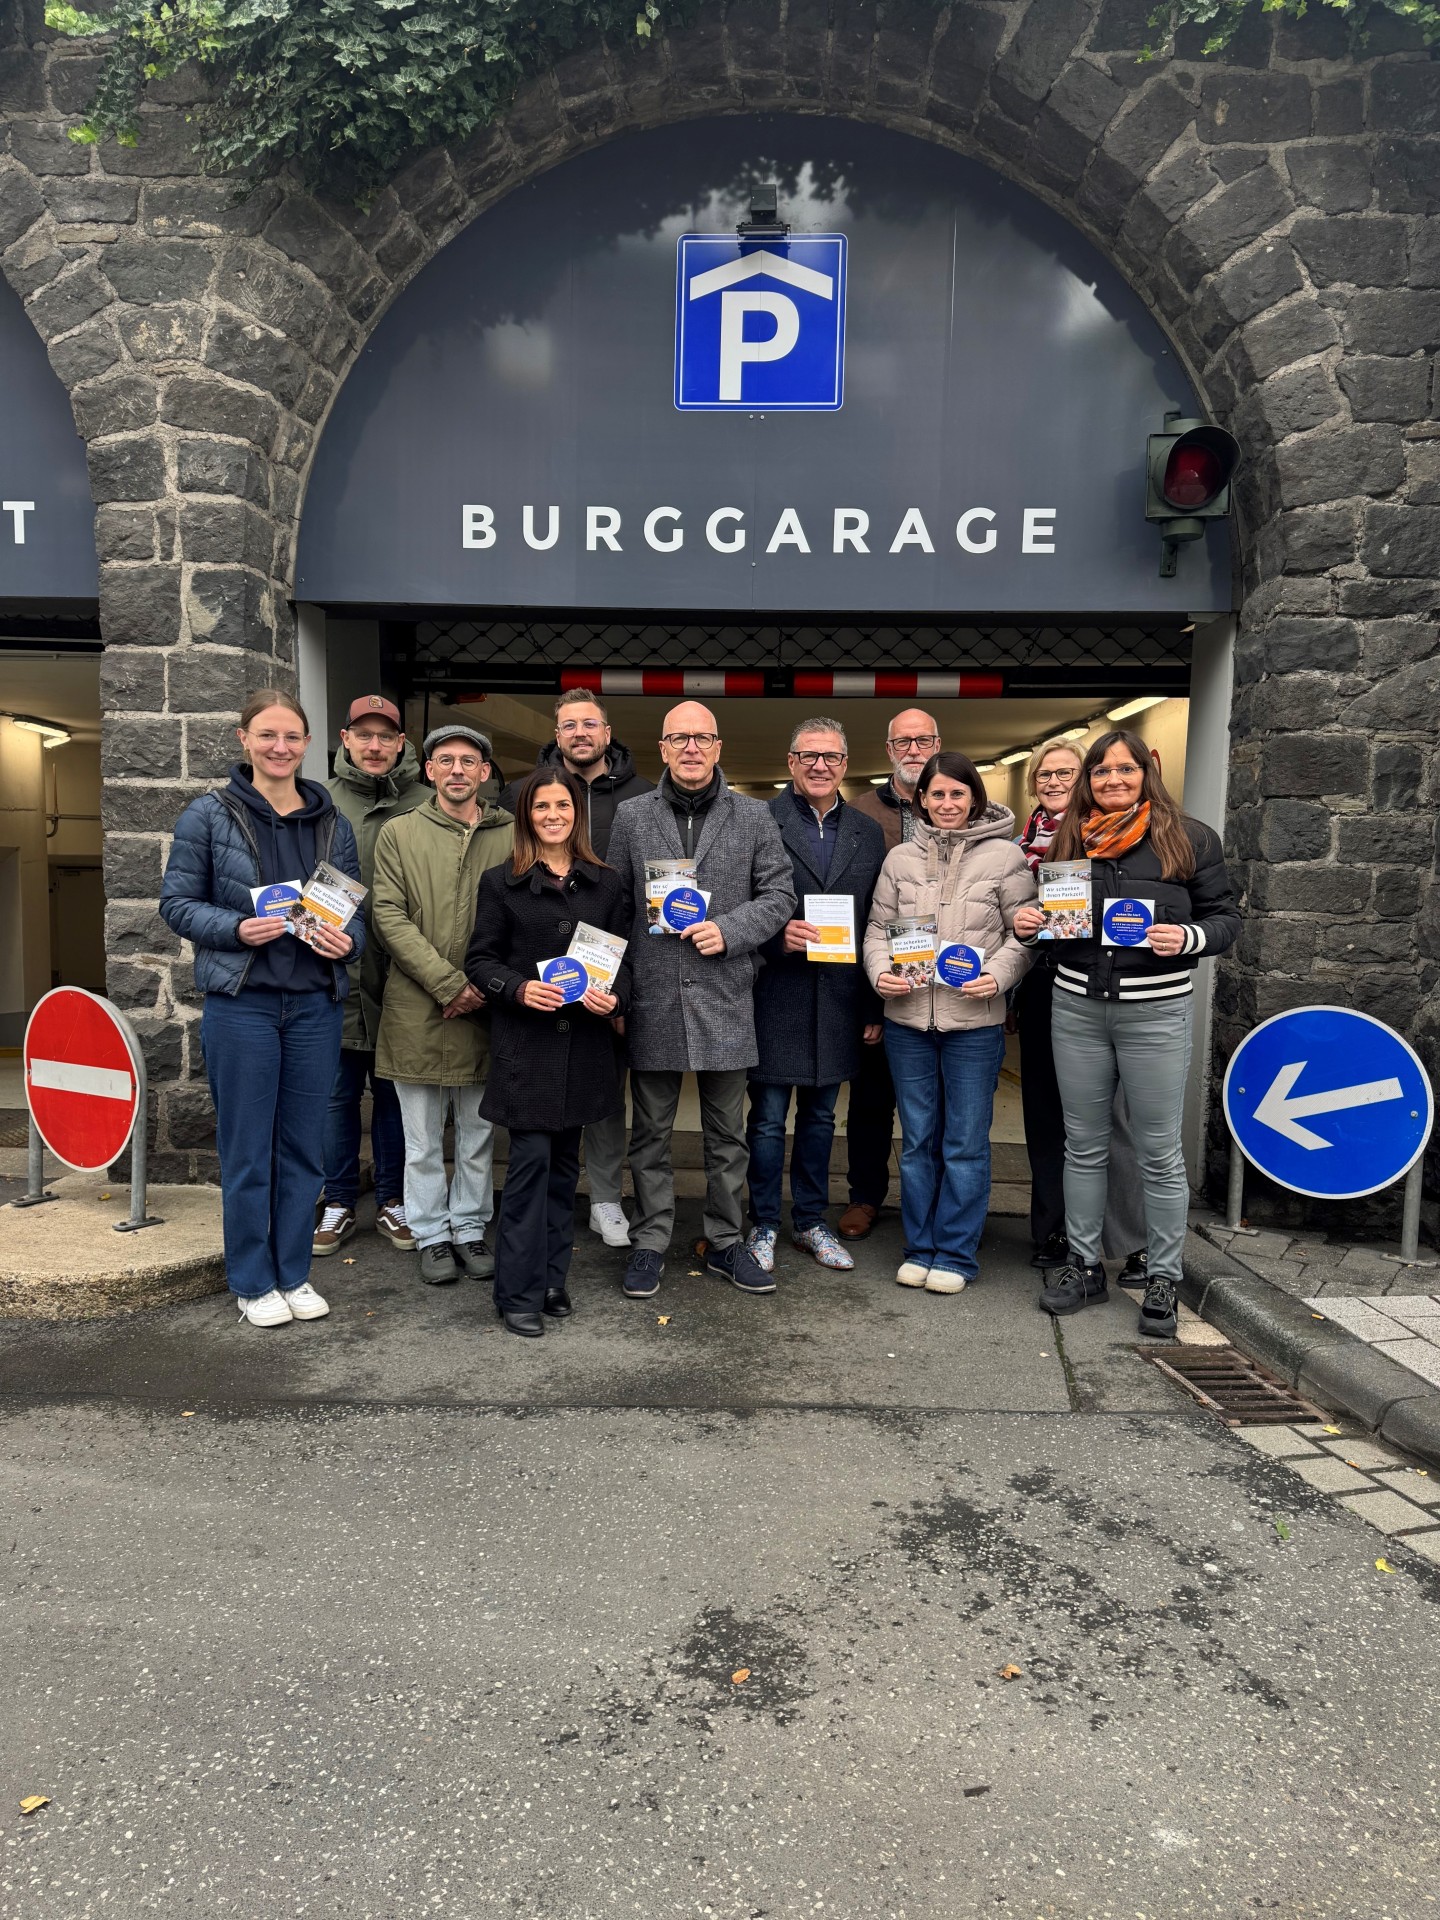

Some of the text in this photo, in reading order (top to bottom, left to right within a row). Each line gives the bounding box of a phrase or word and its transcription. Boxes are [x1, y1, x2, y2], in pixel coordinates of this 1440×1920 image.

[719, 291, 800, 401] P
[462, 504, 1056, 553] BURGGARAGE
[313, 886, 345, 907] Wir schenken
